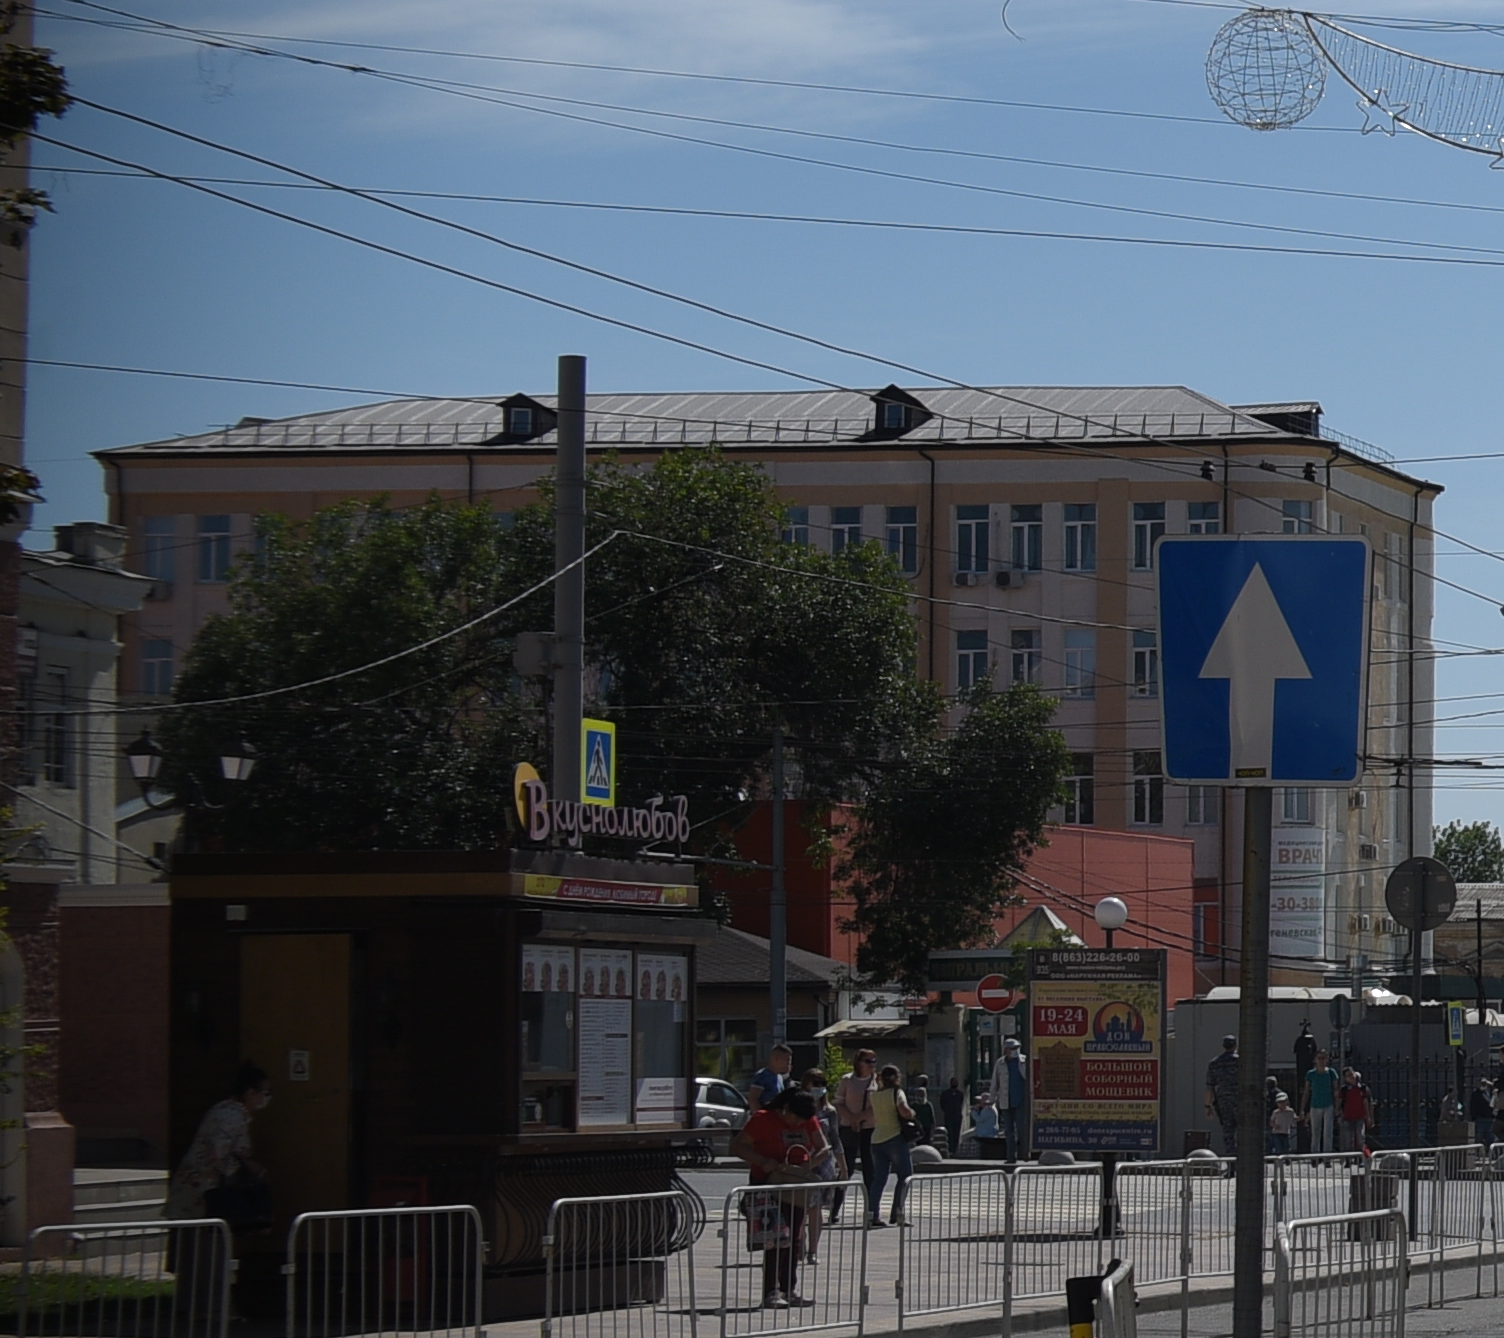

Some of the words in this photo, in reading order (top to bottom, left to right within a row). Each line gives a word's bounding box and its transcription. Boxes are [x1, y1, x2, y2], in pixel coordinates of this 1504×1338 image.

[525, 779, 690, 847] Вкуснолюбов
[1052, 952, 1140, 964] 8(863)226-26-00
[1040, 1008, 1084, 1022] 19-24
[1046, 1024, 1077, 1034] МАЯ
[1106, 1031, 1131, 1041] ДОН
[1086, 1061, 1152, 1072] БОЛЬШОЙ
[1084, 1073, 1153, 1084] СОБОРНЫЙ
[1085, 1087, 1153, 1098] МОЩЕВИК
